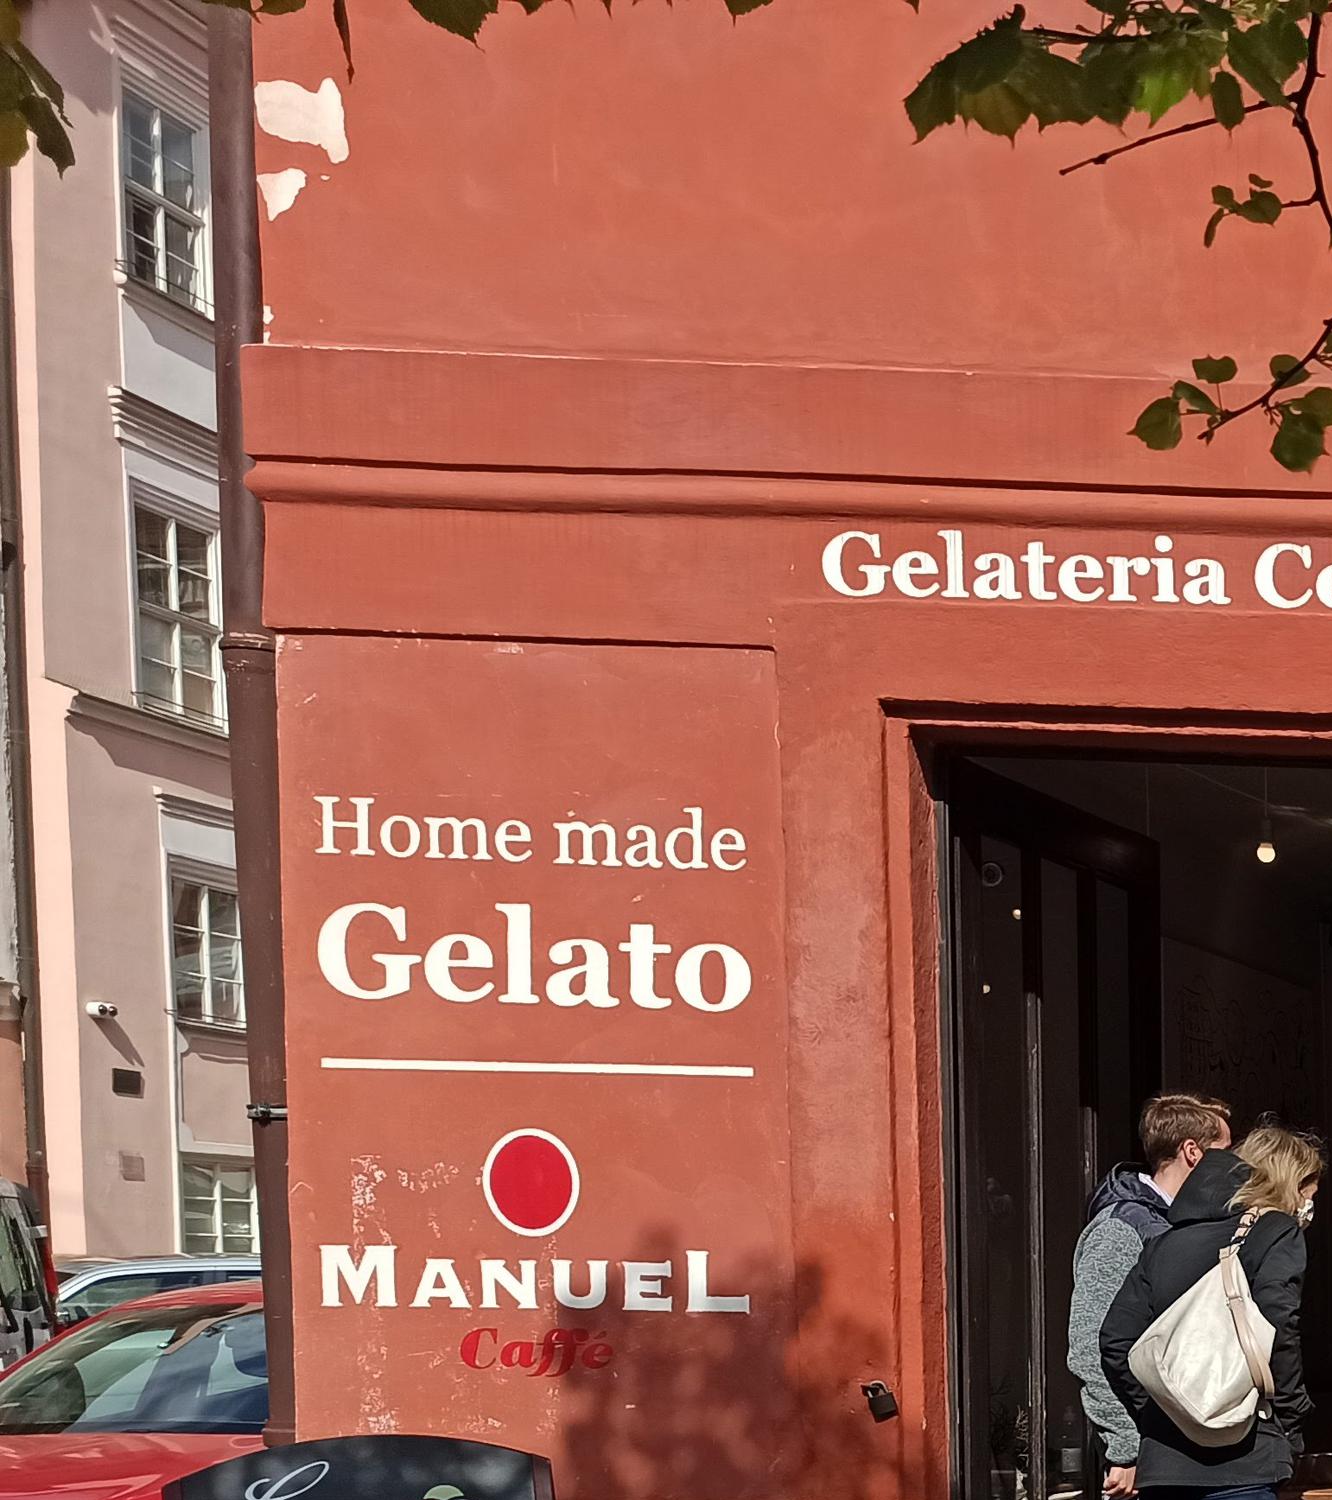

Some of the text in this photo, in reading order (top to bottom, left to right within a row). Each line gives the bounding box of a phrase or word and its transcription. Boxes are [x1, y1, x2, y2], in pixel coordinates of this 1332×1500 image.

[821, 530, 1231, 605] Gelateria
[314, 796, 748, 871] Home made
[317, 902, 752, 1012] Gelato
[319, 1245, 750, 1314] MANUEL
[460, 1327, 614, 1377] Caffé
